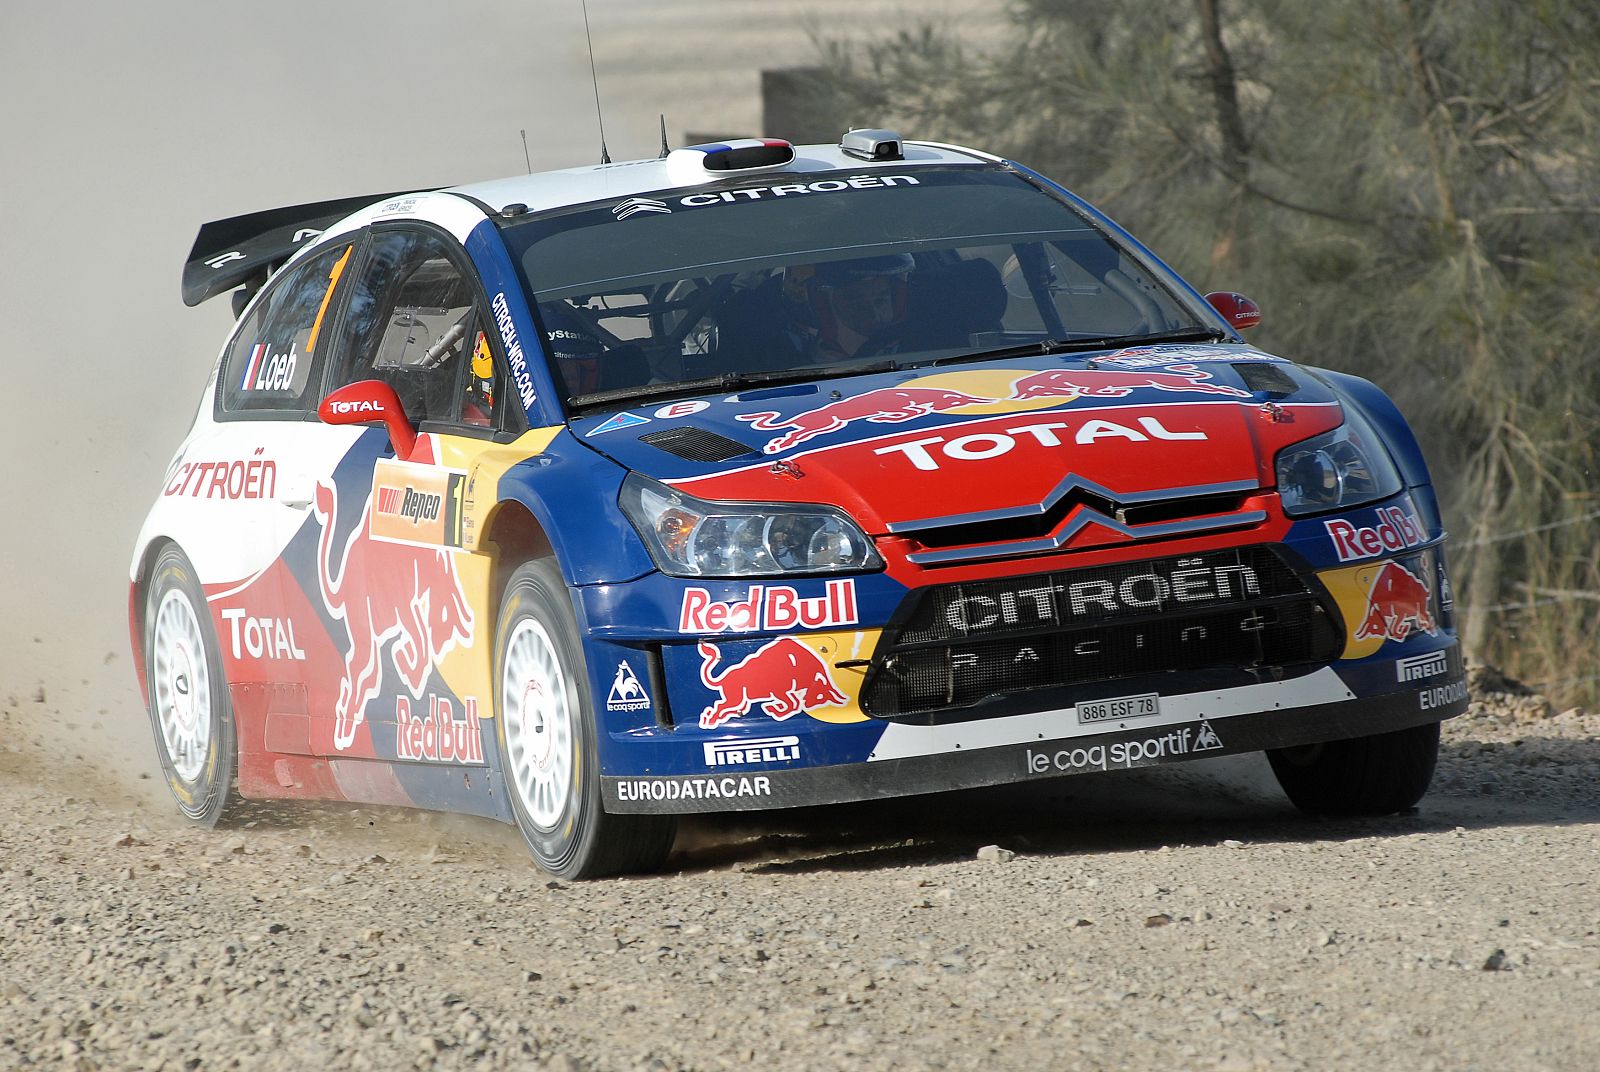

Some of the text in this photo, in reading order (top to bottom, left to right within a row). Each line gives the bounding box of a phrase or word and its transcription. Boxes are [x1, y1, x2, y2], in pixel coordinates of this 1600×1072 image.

[306, 244, 353, 353] 1
[256, 343, 297, 391] Loeb
[492, 292, 537, 410] CITROEN-WRC.COM
[330, 400, 385, 415] TOTAL
[669, 403, 697, 416] E
[873, 417, 1208, 470] TOTAL
[164, 447, 277, 500] CITROËN
[400, 487, 441, 524] Repco
[453, 476, 464, 545] 1
[1324, 508, 1406, 562] Red
[678, 579, 859, 633] Red Bull
[221, 608, 306, 660] TOTAL
[1396, 650, 1447, 683] PIRELLI
[396, 693, 484, 763] Red Bull
[1083, 699, 1154, 720] 886 ESF 78
[703, 735, 801, 766] PIRELLI
[1026, 727, 1191, 774] le coq sportif
[617, 777, 771, 801] EURODATACAR
